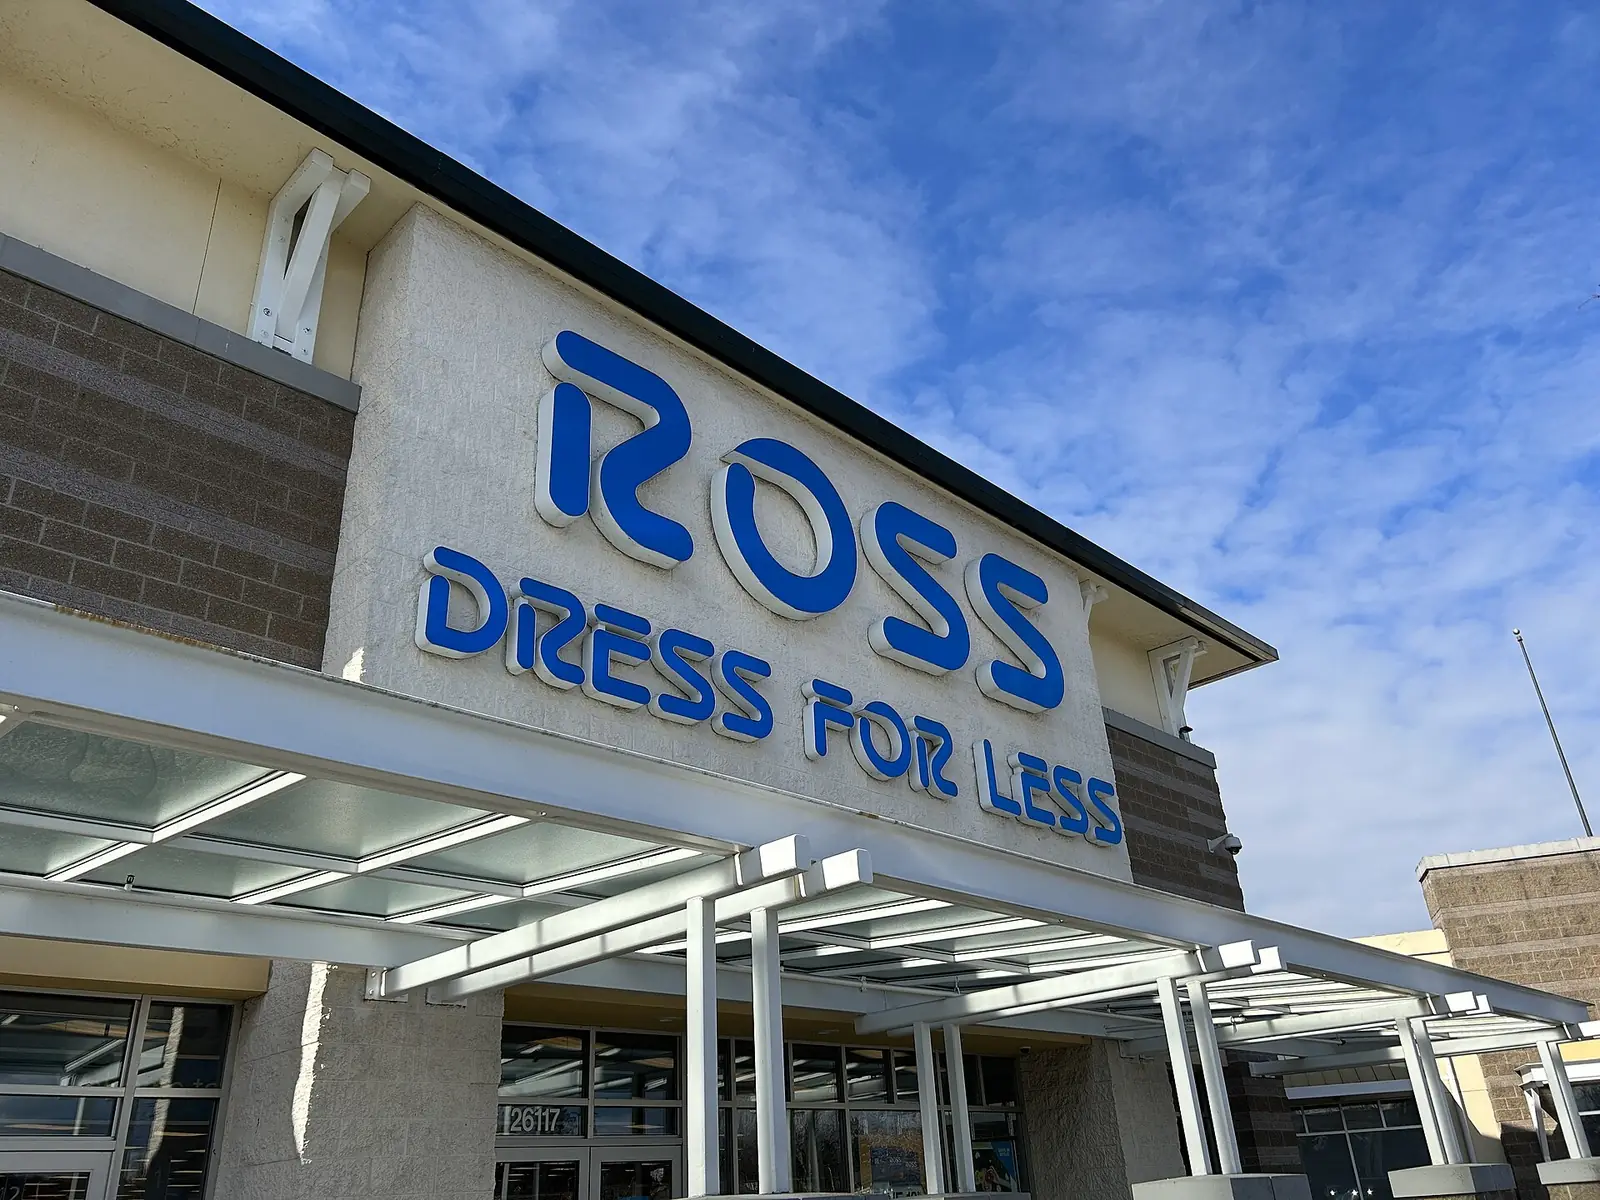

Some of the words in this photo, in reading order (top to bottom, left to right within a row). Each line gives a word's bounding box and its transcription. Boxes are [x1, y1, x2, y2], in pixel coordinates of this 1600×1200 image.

[537, 330, 1065, 713] ROSS
[416, 545, 774, 741] DRESS
[802, 678, 959, 799] FOR
[973, 738, 1122, 846] LESS
[510, 1107, 561, 1132] 26117
